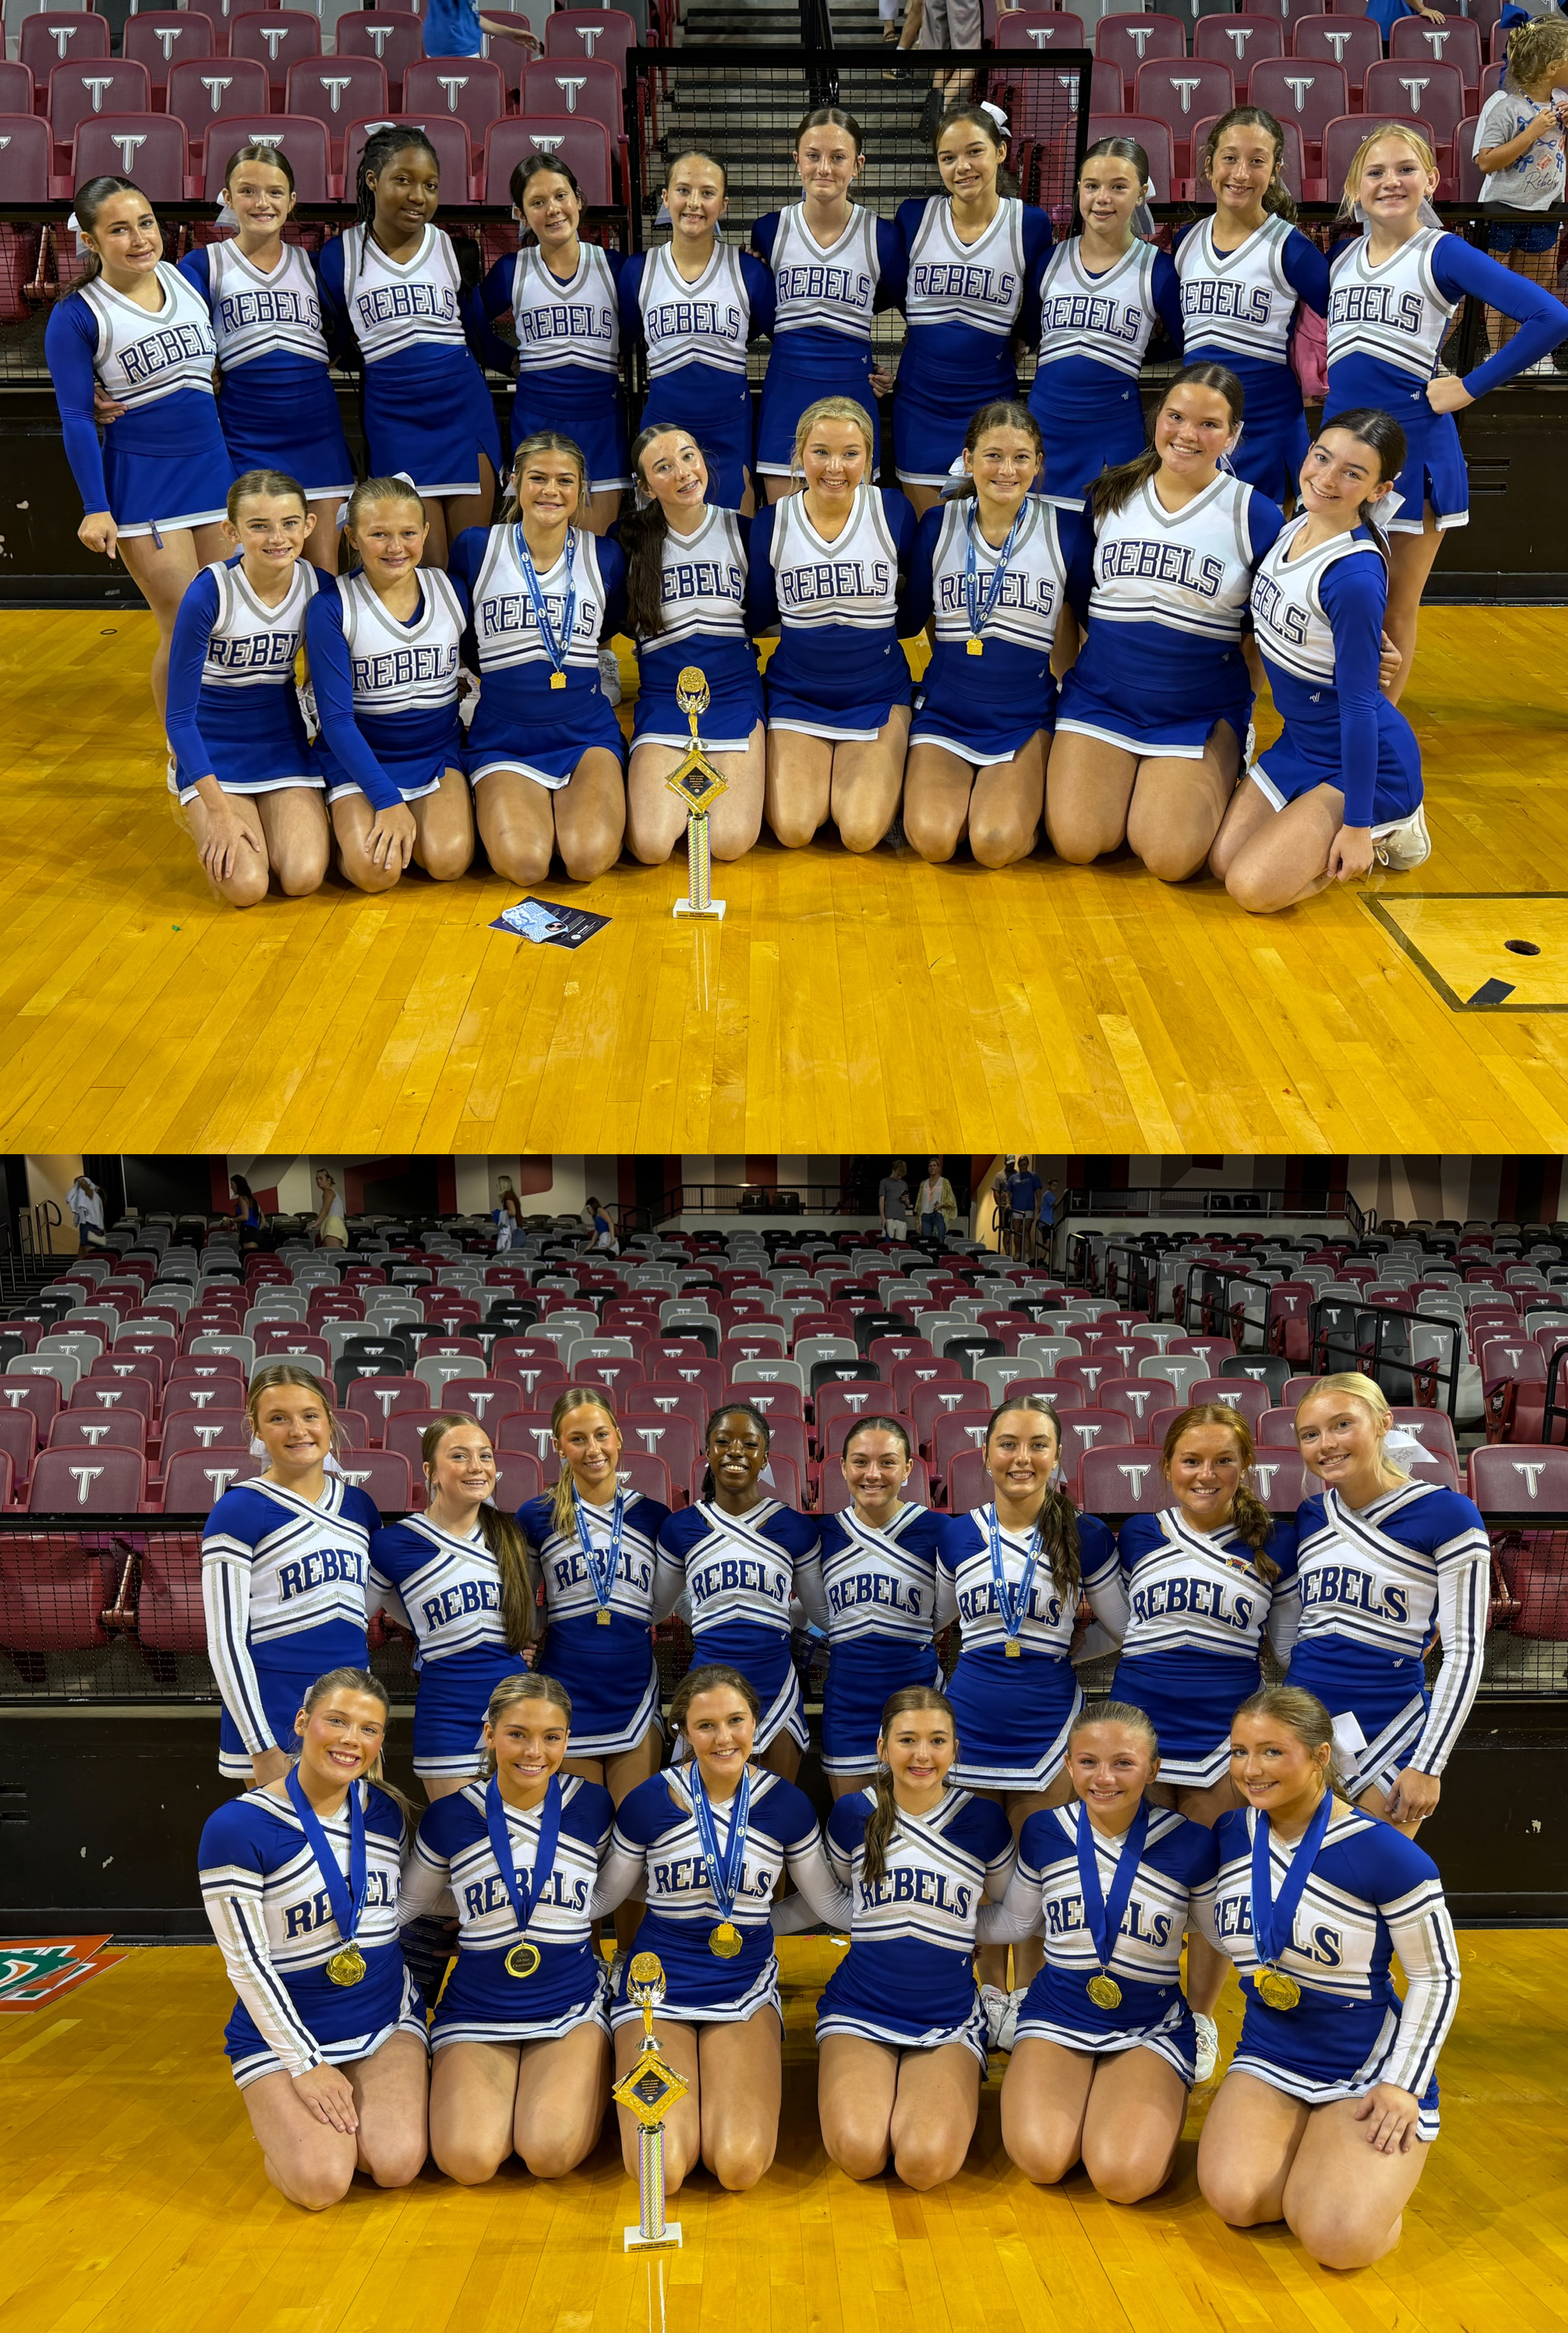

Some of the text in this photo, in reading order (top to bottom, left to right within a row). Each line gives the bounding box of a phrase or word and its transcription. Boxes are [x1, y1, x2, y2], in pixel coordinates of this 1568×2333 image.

[48, 27, 77, 59] T
[154, 28, 182, 60] T
[259, 28, 289, 60] T
[365, 26, 394, 58] T
[575, 27, 604, 58] T
[1126, 28, 1154, 58] T
[1226, 28, 1253, 59] T
[1324, 32, 1352, 62] T
[1423, 31, 1450, 61] T
[82, 77, 114, 113] T
[201, 77, 232, 112] T
[320, 77, 352, 113] T
[437, 76, 469, 112] T
[555, 77, 586, 113] T
[1170, 78, 1201, 114] T
[1284, 77, 1315, 112] T
[1399, 77, 1430, 113] T
[111, 135, 147, 174] T
[1524, 170, 1560, 192] Rebels
[778, 264, 870, 308] REBELS
[913, 262, 1016, 305] REBELS
[220, 289, 321, 334] REBELS
[355, 283, 455, 332] REBELS
[521, 301, 614, 342] REBELS
[647, 301, 740, 343] REBELS
[1041, 294, 1143, 343] REBELS
[1328, 284, 1423, 335] EBELS
[1005, 526, 1015, 556] All-American
[525, 563, 536, 594] All-American
[662, 560, 742, 604] EBELS
[779, 560, 889, 606] REBELS
[1100, 538, 1226, 599] REBELS
[986, 581, 999, 612] All-American
[1250, 571, 1308, 646] BELS
[542, 619, 554, 651] All-American
[564, 606, 572, 639] All-American
[209, 629, 301, 669] REBEL
[352, 643, 459, 693] REBELS
[752, 1195, 760, 1204] T
[782, 1195, 791, 1204] T
[484, 1294, 497, 1307] T
[535, 1295, 551, 1309] T
[589, 1296, 604, 1309] T
[1243, 1287, 1256, 1300] T
[1284, 1297, 1298, 1311] T
[384, 1317, 400, 1335] T
[442, 1318, 459, 1336] T
[967, 1306, 983, 1320] T
[1027, 1306, 1043, 1320] T
[1056, 1320, 1073, 1336] T
[1086, 1307, 1102, 1321] T
[1116, 1320, 1133, 1336] T
[1326, 1309, 1341, 1325] T
[409, 1332, 429, 1352] T
[477, 1333, 496, 1353] T
[1039, 1347, 1061, 1369] T
[1115, 1346, 1136, 1367] T
[1150, 1334, 1169, 1353] T
[1431, 1335, 1450, 1353] T
[1504, 1348, 1523, 1369] T
[519, 1369, 542, 1393] T
[1079, 1367, 1103, 1390] T
[1164, 1367, 1188, 1389] T
[373, 1390, 401, 1418] T
[468, 1392, 495, 1420] T
[1125, 1390, 1152, 1418] T
[68, 1467, 105, 1505] T
[1117, 1464, 1151, 1501] T
[1512, 1462, 1546, 1499] T
[277, 1547, 369, 1604] REBEL
[692, 1557, 786, 1607] REBELS
[1021, 1574, 1031, 1606] All-American
[421, 1578, 504, 1634] REBE
[828, 1571, 922, 1617] REBELS
[999, 1589, 1009, 1620] All-American
[1132, 1575, 1254, 1631] REBELS
[698, 1805, 706, 1839] All-American
[653, 1855, 772, 1899] REBLS
[710, 1866, 721, 1899] All-American
[732, 1853, 740, 1887] All-American
[283, 1868, 401, 1943] REEL
[1046, 1892, 1173, 1949] RELS
